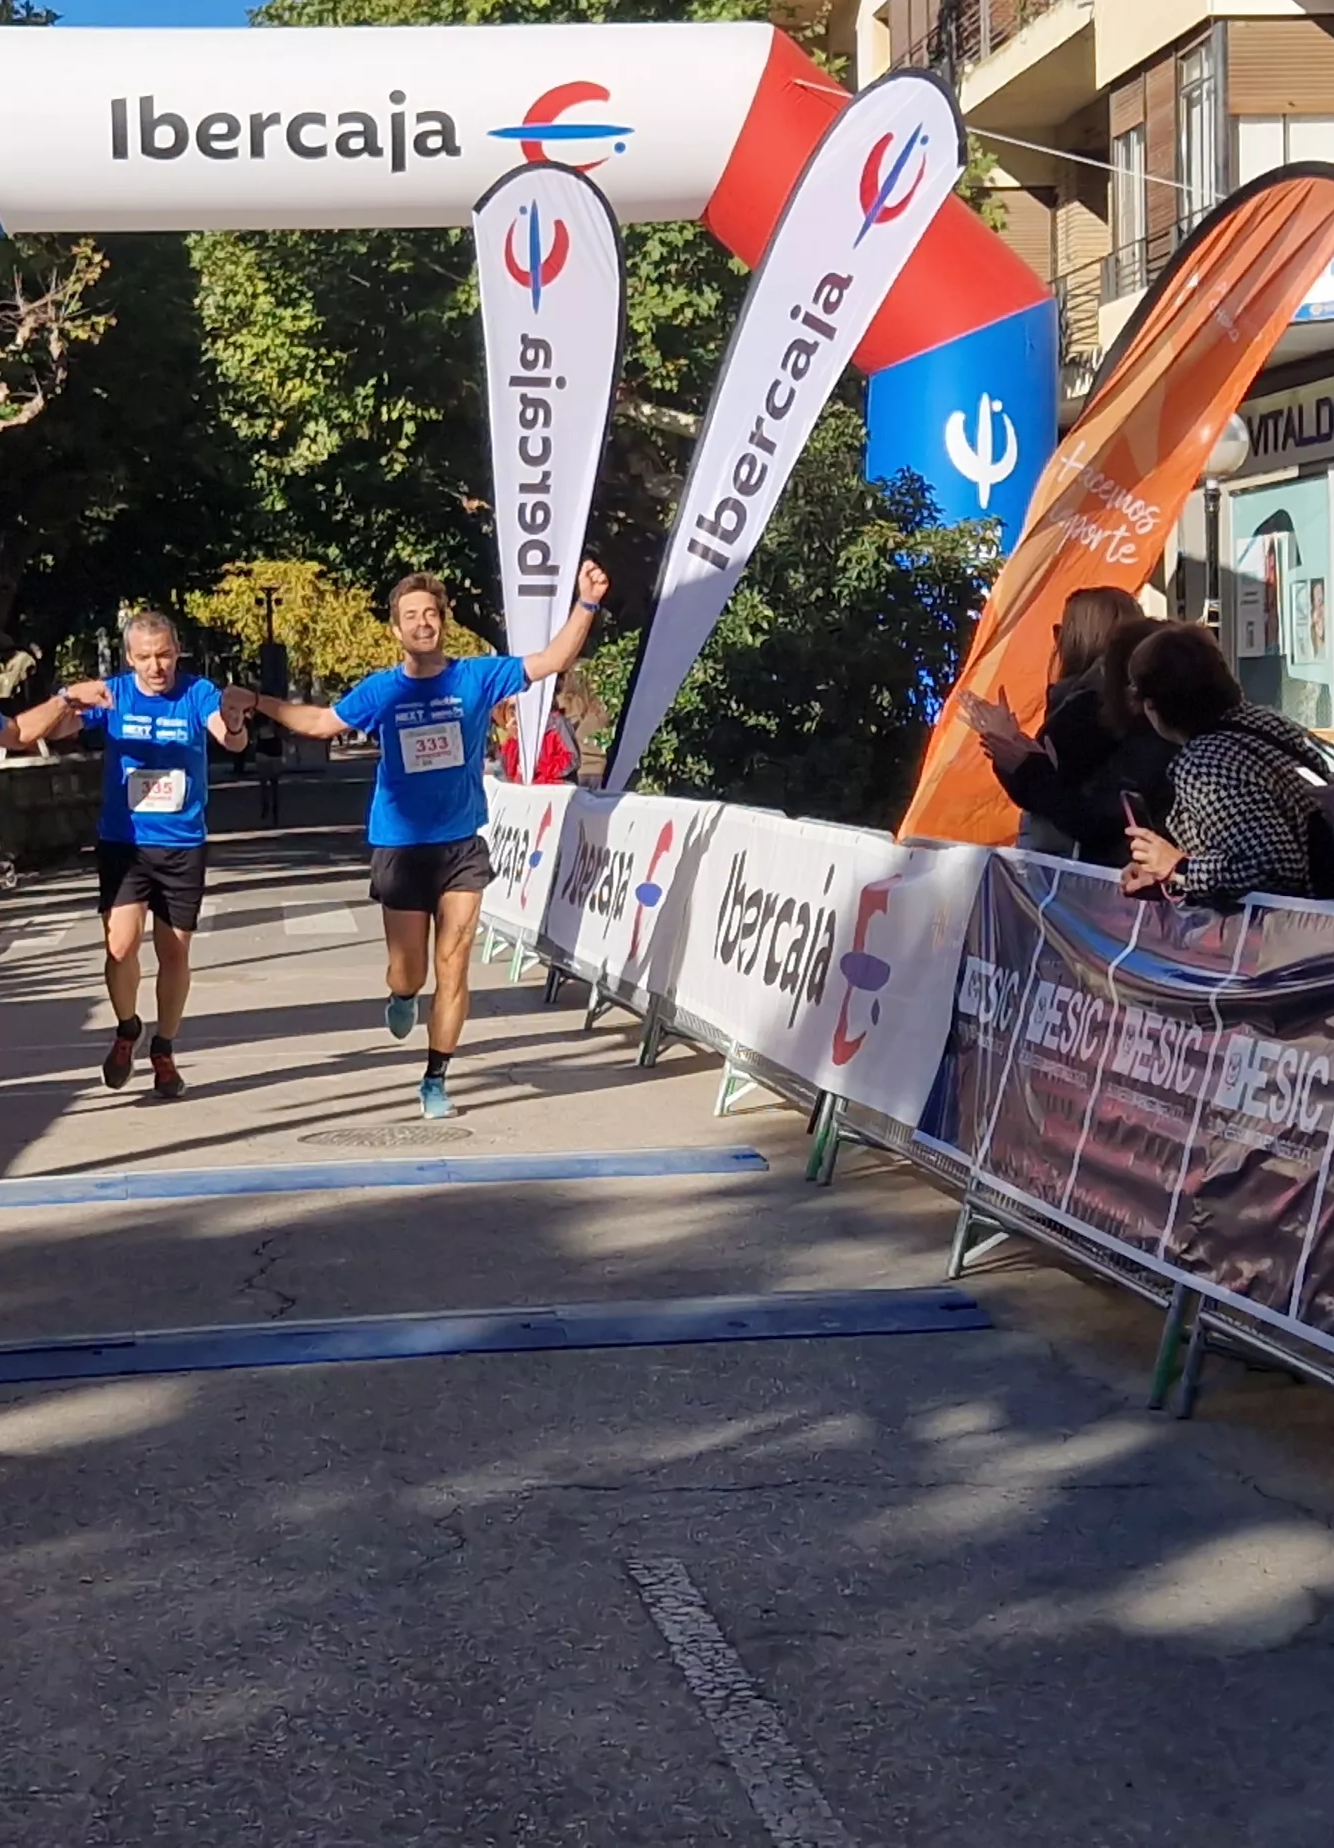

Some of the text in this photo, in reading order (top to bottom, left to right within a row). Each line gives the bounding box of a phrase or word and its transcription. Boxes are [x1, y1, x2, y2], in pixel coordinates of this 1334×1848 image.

[110, 89, 462, 173] Ibercaja
[686, 270, 854, 572] Ibercaja
[415, 736, 449, 753] 333
[141, 781, 173, 795] 335
[714, 849, 837, 1029] Ibercaja
[1042, 985, 1105, 1062] ESIC
[1130, 1010, 1204, 1094] ESIC
[1241, 1038, 1330, 1134] ESIC
